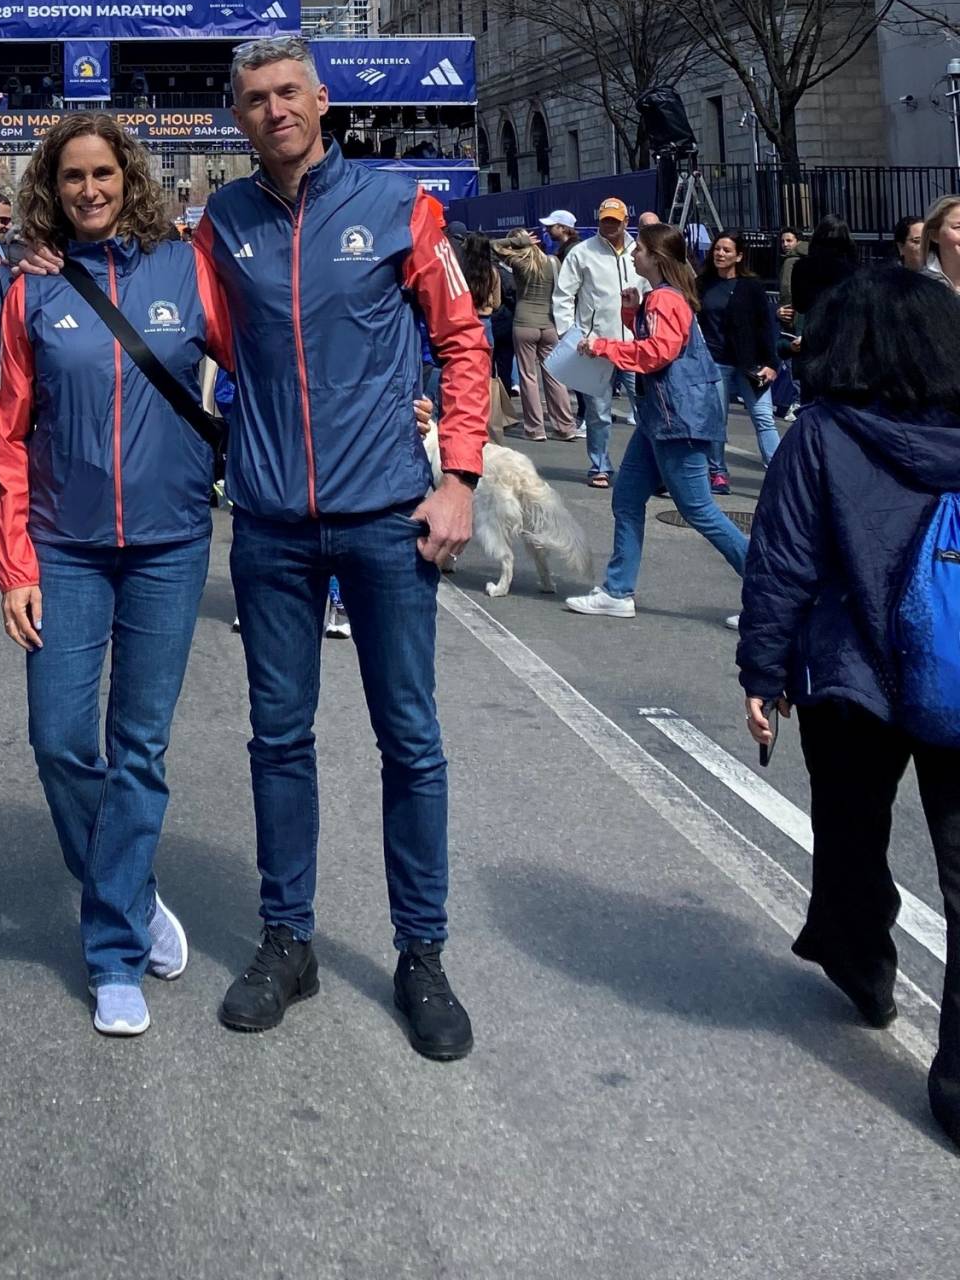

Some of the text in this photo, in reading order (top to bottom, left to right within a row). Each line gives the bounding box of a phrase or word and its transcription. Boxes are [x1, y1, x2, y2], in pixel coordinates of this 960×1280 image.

[28, 4, 92, 18] BOSTON
[330, 57, 411, 65] BANK OF AMERICA
[116, 113, 157, 126] EXPO
[161, 113, 213, 125] HOURS
[149, 126, 192, 136] SUNDAY
[194, 126, 243, 136] 9AM-6PM
